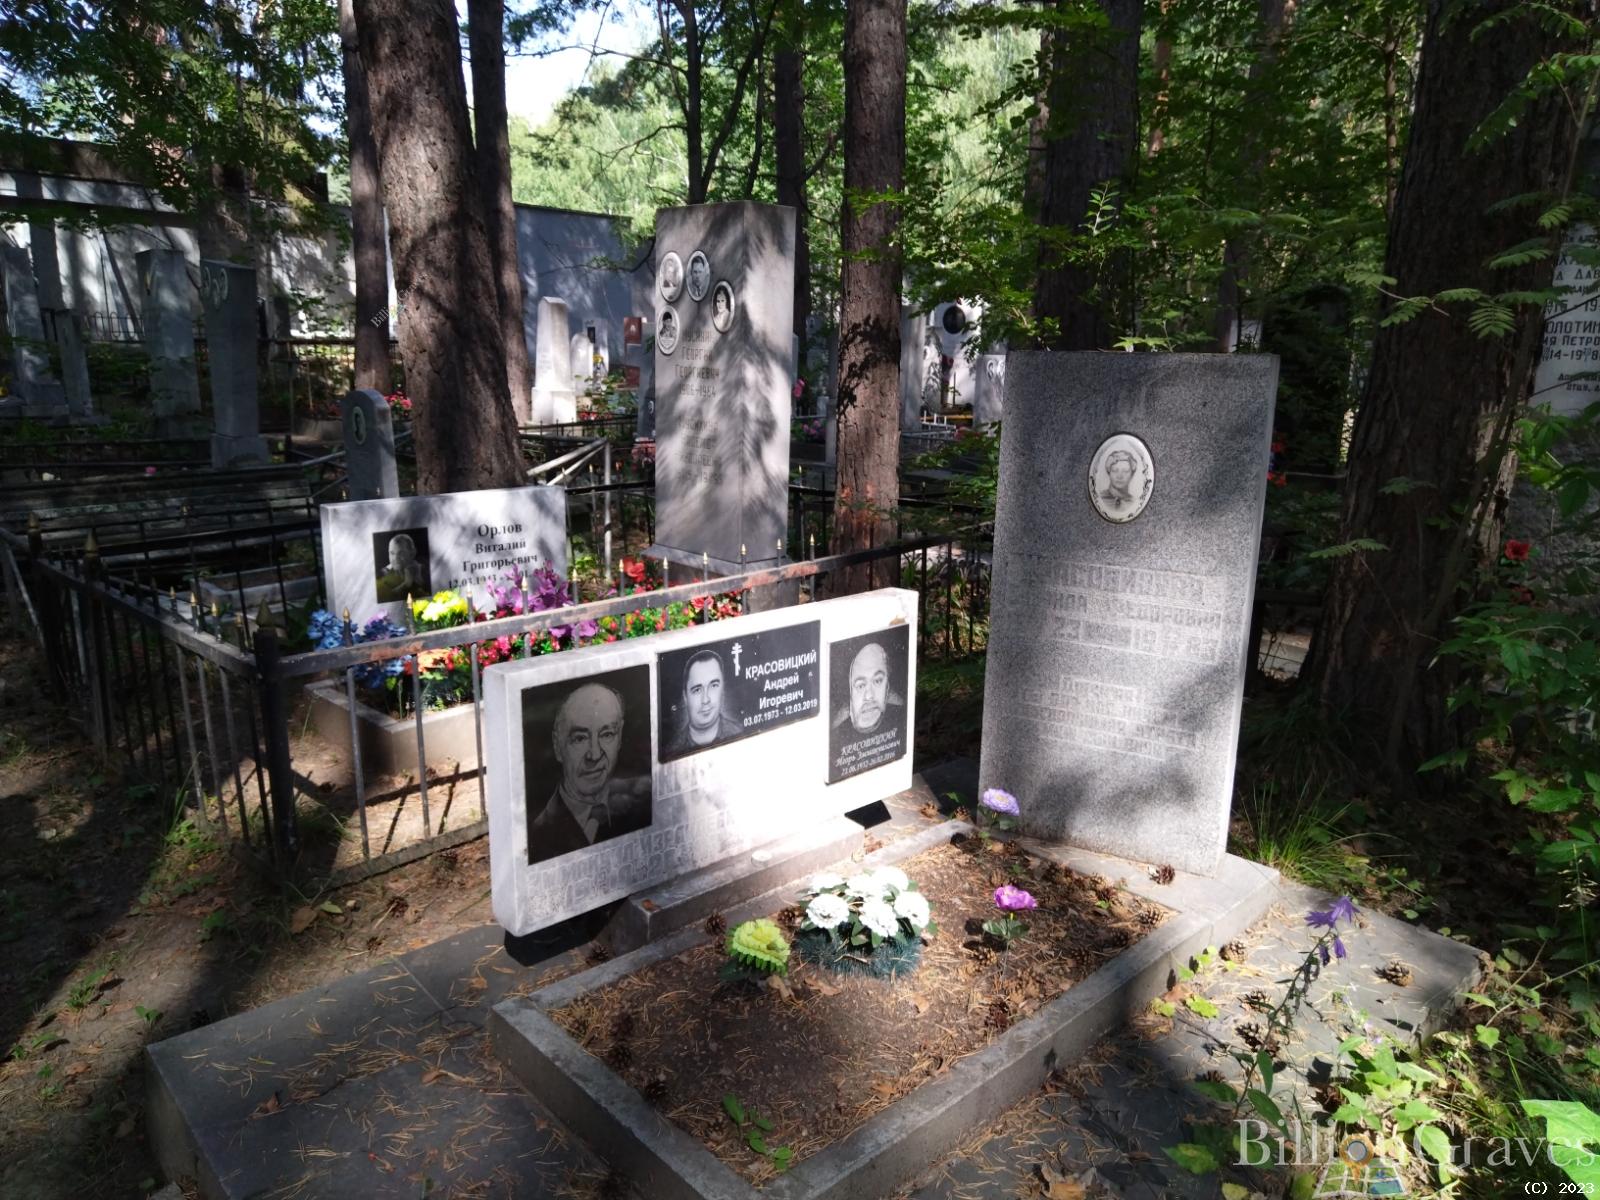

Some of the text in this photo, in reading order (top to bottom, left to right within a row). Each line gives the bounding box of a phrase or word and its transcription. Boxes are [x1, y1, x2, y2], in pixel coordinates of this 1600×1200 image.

[477, 523, 523, 539] Орлов
[474, 540, 527, 554] Виталий
[462, 554, 538, 572] Григорьевич
[745, 649, 817, 680] КРАСОВИЦКИЙ
[763, 672, 799, 692] Андрей
[759, 689, 804, 710] Игоревич
[743, 709, 780, 727] 03.07.1973
[784, 698, 818, 716] 12.03.2019
